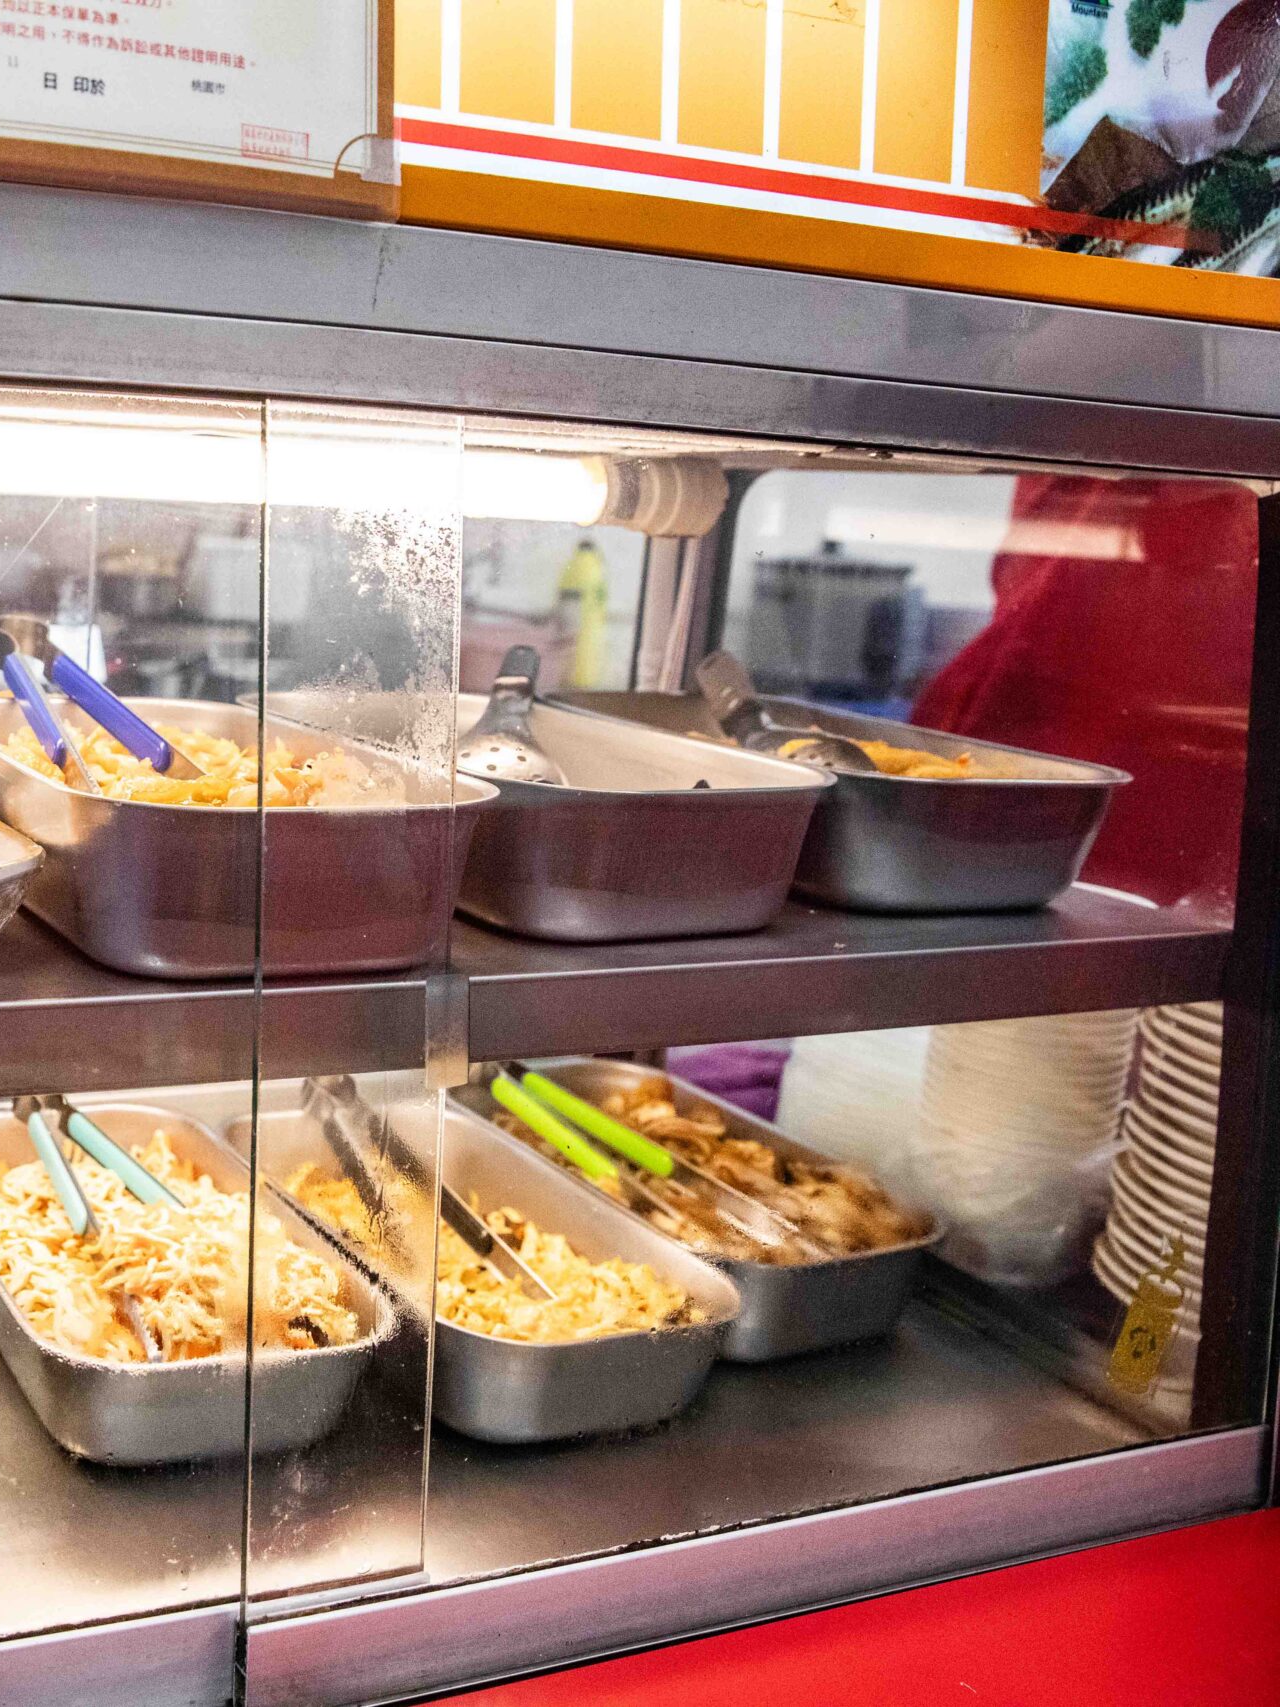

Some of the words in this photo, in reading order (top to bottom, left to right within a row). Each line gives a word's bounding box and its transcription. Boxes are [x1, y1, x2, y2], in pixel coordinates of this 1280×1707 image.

[1071, 2, 1108, 19] Mountain
[44, 72, 58, 90] 日
[73, 76, 106, 95] 印於
[191, 80, 225, 94] 桃園市
